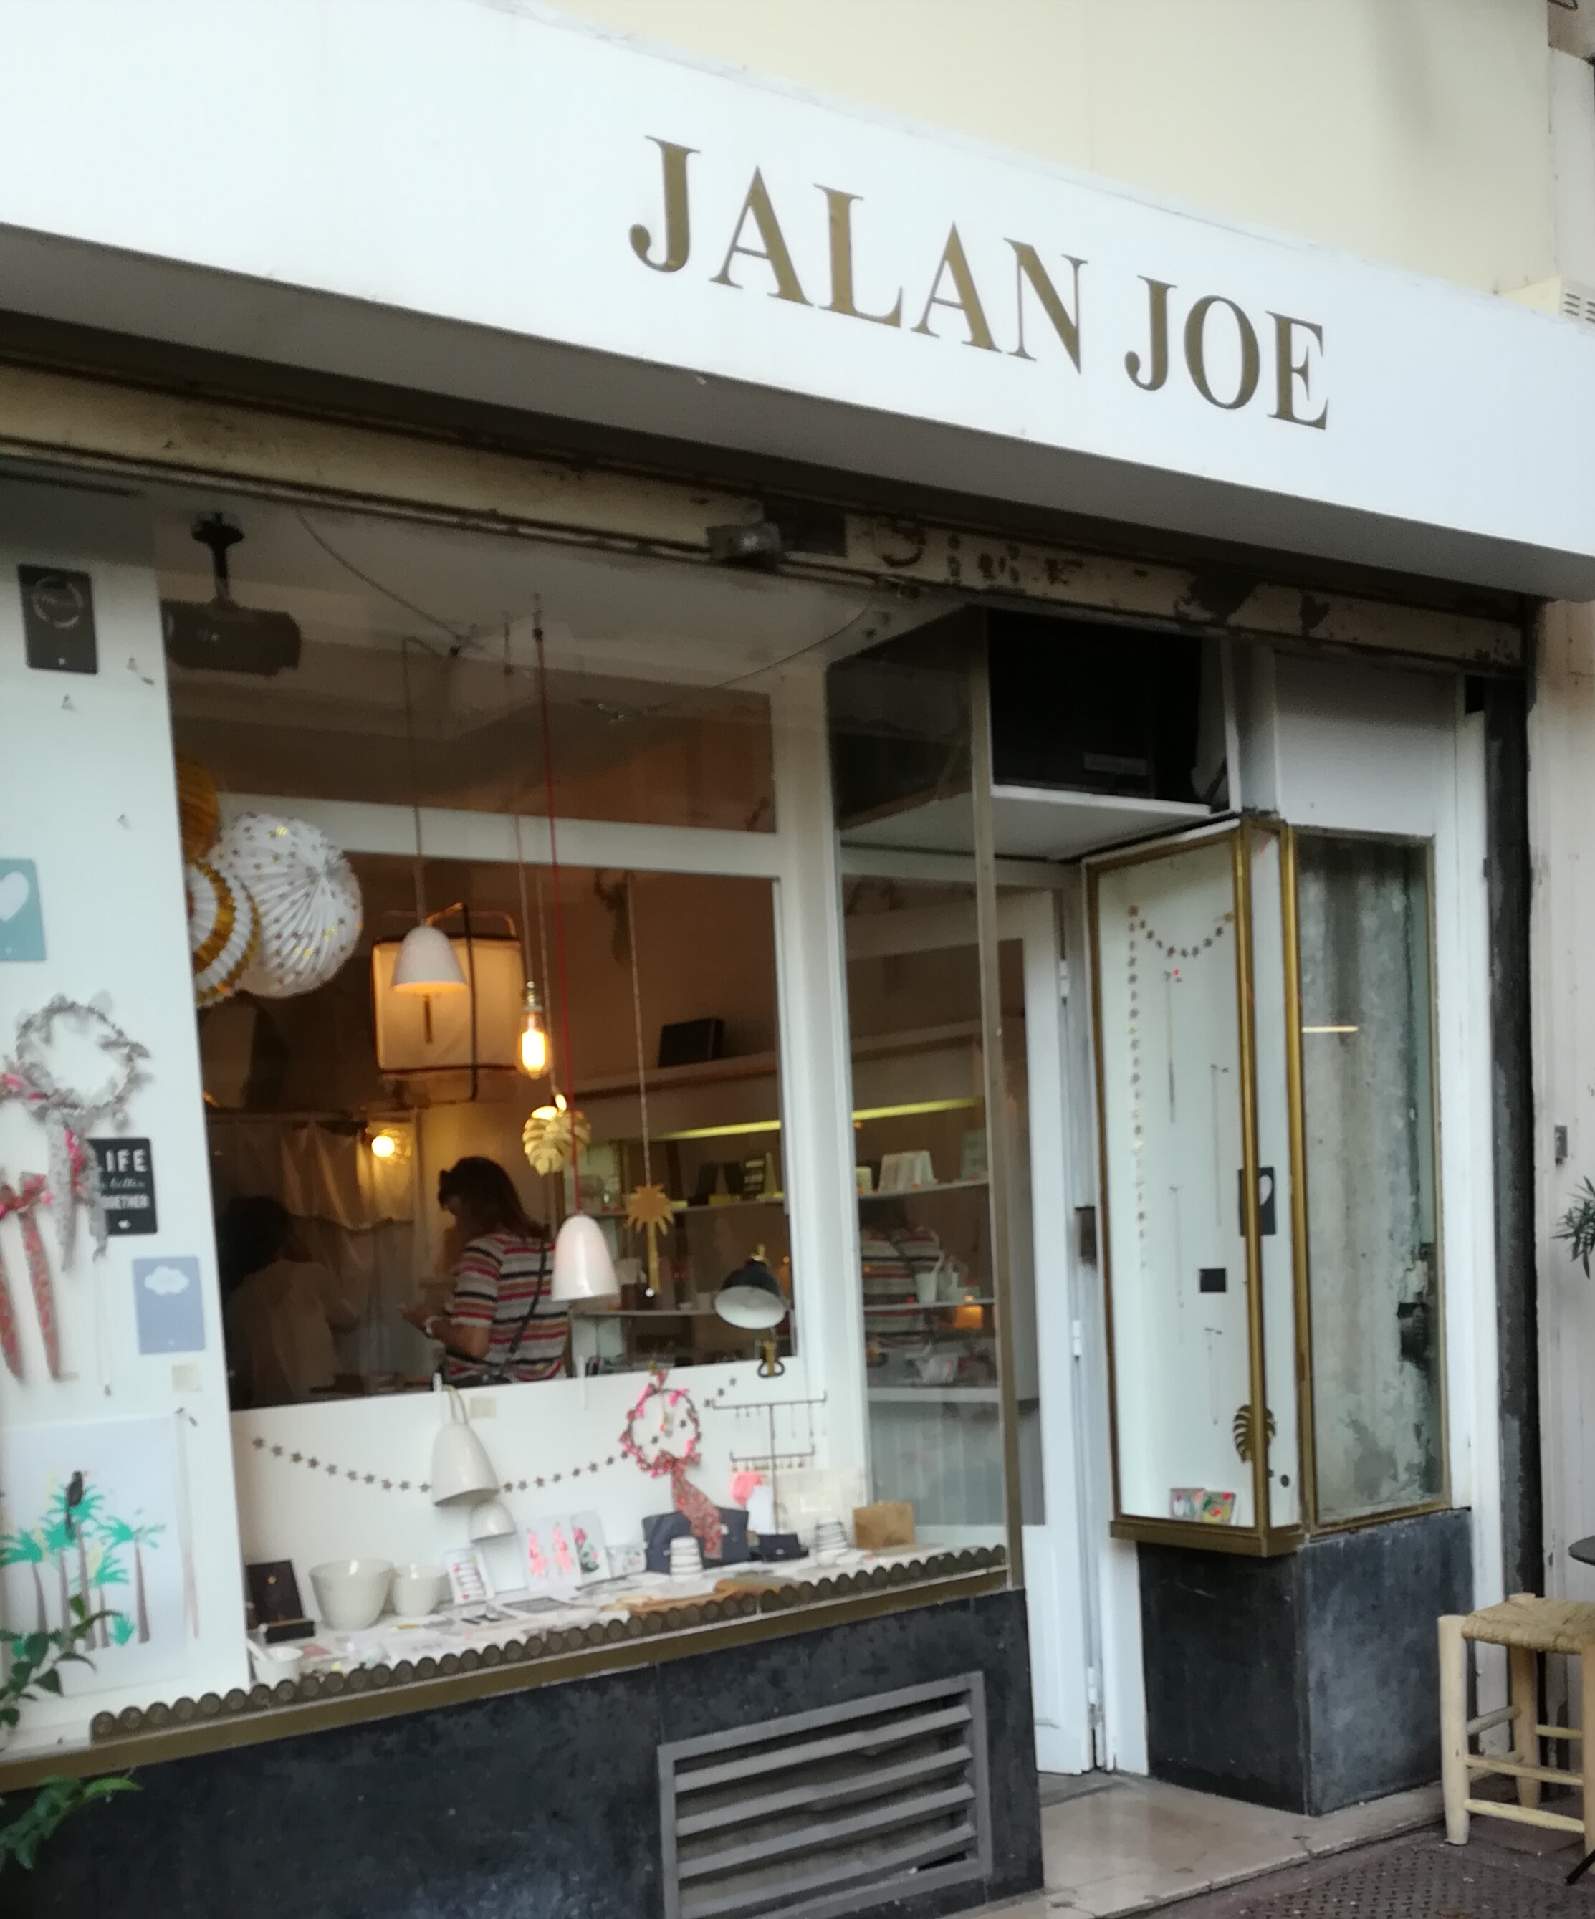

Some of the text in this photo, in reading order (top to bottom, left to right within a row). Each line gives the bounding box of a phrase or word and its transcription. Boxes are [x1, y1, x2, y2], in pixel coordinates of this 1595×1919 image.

[629, 135, 1329, 430] JALAN JOE
[99, 1148, 147, 1173] IFE
